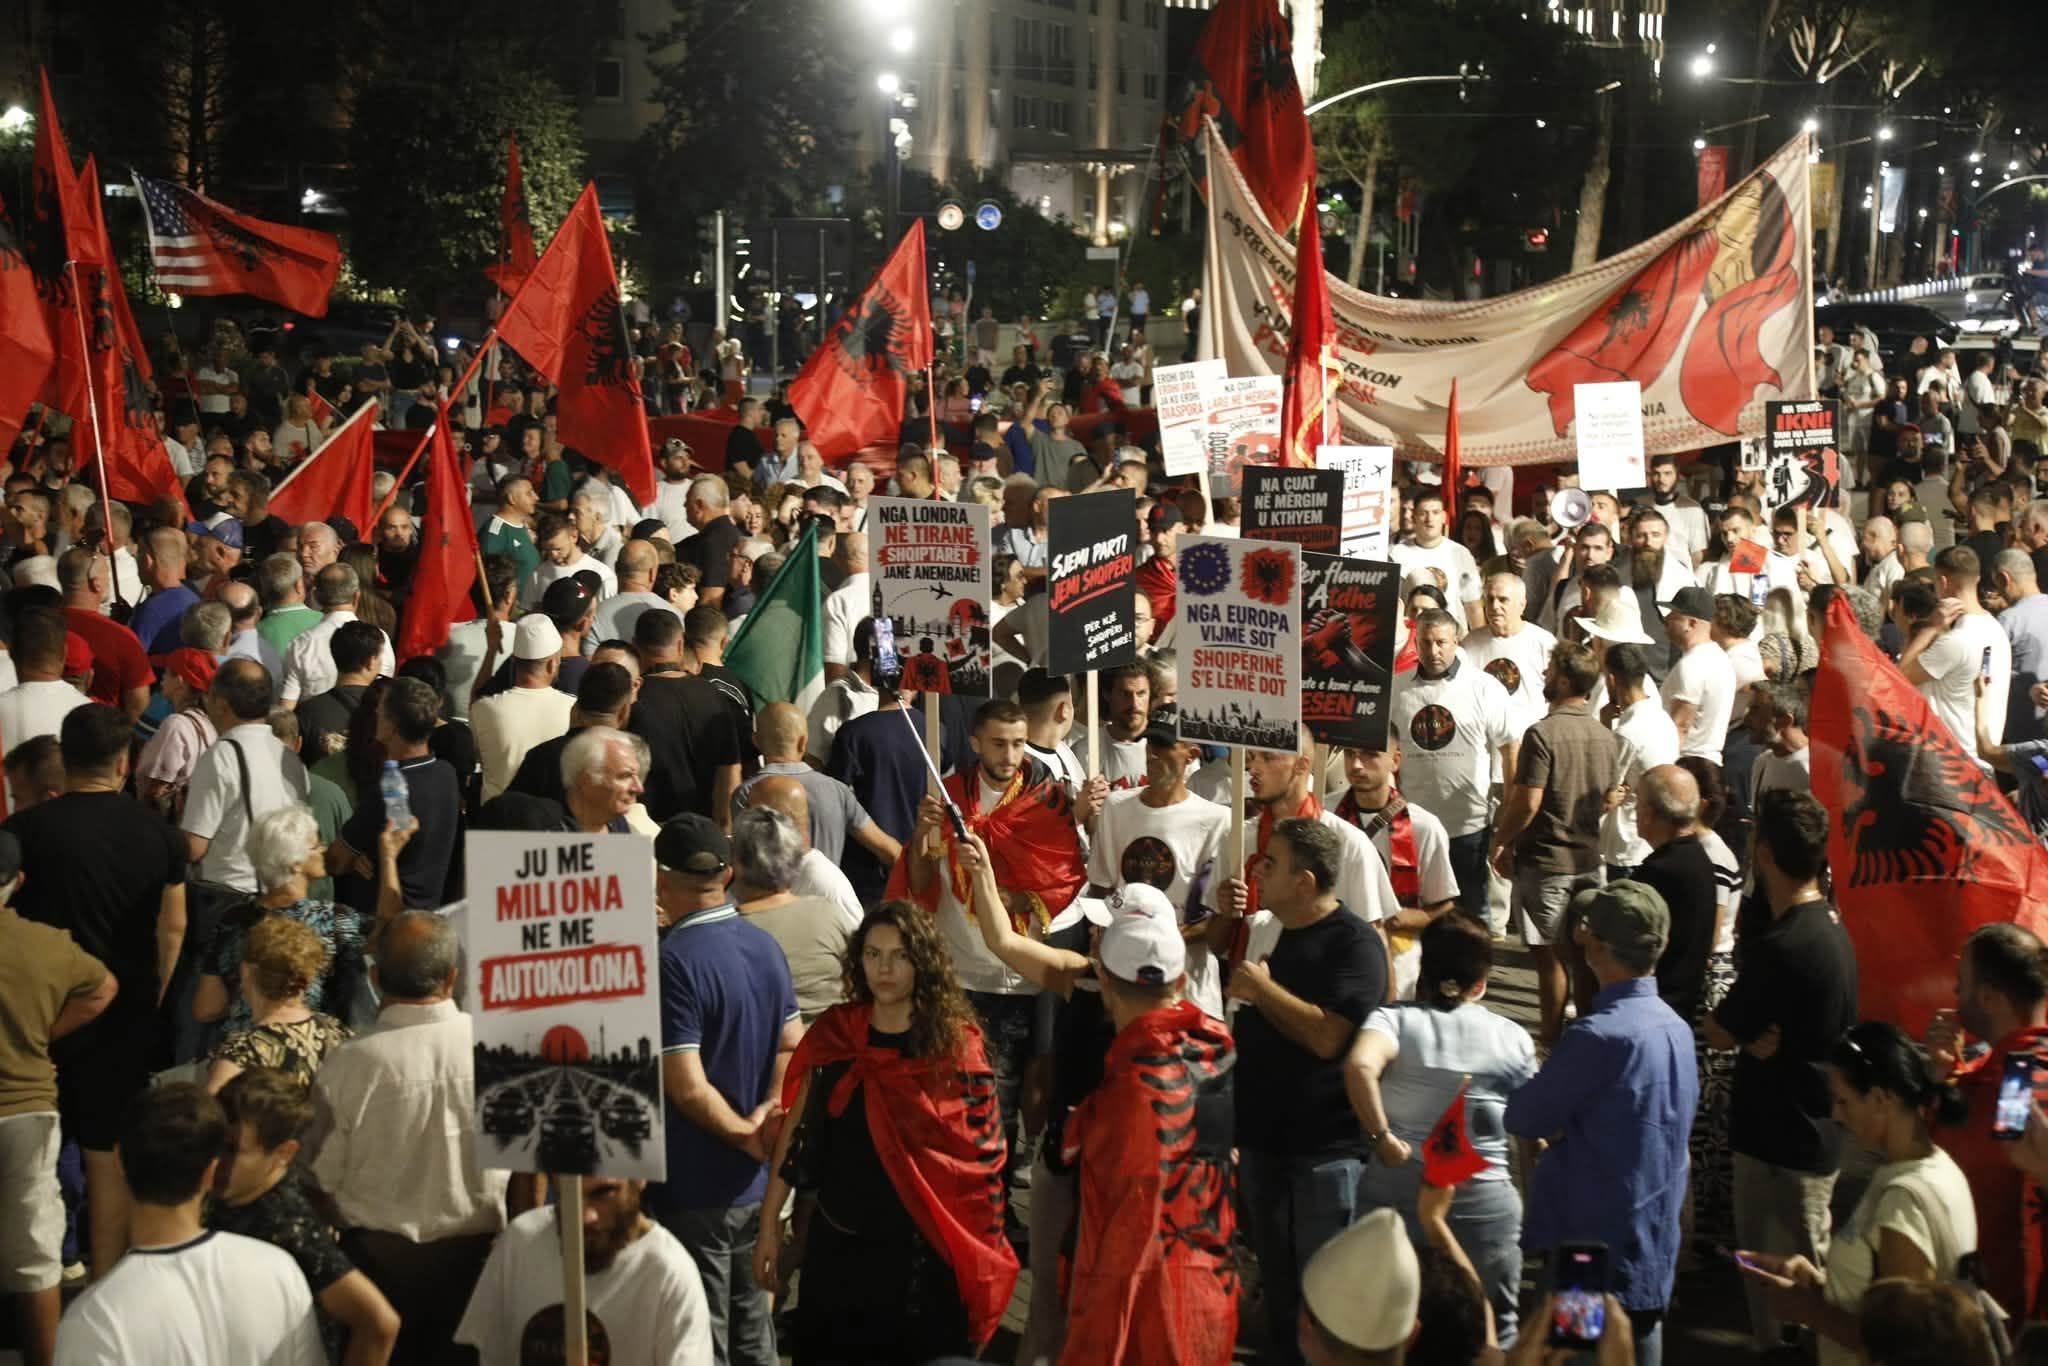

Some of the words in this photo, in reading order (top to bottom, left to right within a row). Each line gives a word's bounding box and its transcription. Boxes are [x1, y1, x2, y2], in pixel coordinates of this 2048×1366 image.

[1776, 410, 1833, 432] IKNI!
[1261, 477, 1280, 492] NA
[1254, 493, 1272, 510] NË
[1274, 492, 1328, 509] MËRGIM
[879, 506, 909, 524] NGA
[912, 506, 969, 524] LONDRA
[1258, 511, 1268, 526] U
[1271, 509, 1324, 526] KTHYEM
[1051, 547, 1090, 582] SJEMI
[1092, 533, 1129, 564] PARTI
[1323, 561, 1388, 585] flamur
[1050, 574, 1081, 610] JEMI
[1186, 603, 1221, 623] NGA
[1226, 604, 1290, 634] EUROPA
[1249, 629, 1277, 649] SOT
[1259, 676, 1288, 697] DOT
[1301, 691, 1356, 714] ESEN
[516, 849, 547, 879] JU
[558, 843, 595, 875] ME
[496, 874, 624, 923] MILIONA
[522, 923, 551, 950] NE
[560, 917, 595, 948] ME
[489, 950, 641, 1003] AUTOKOLONA
